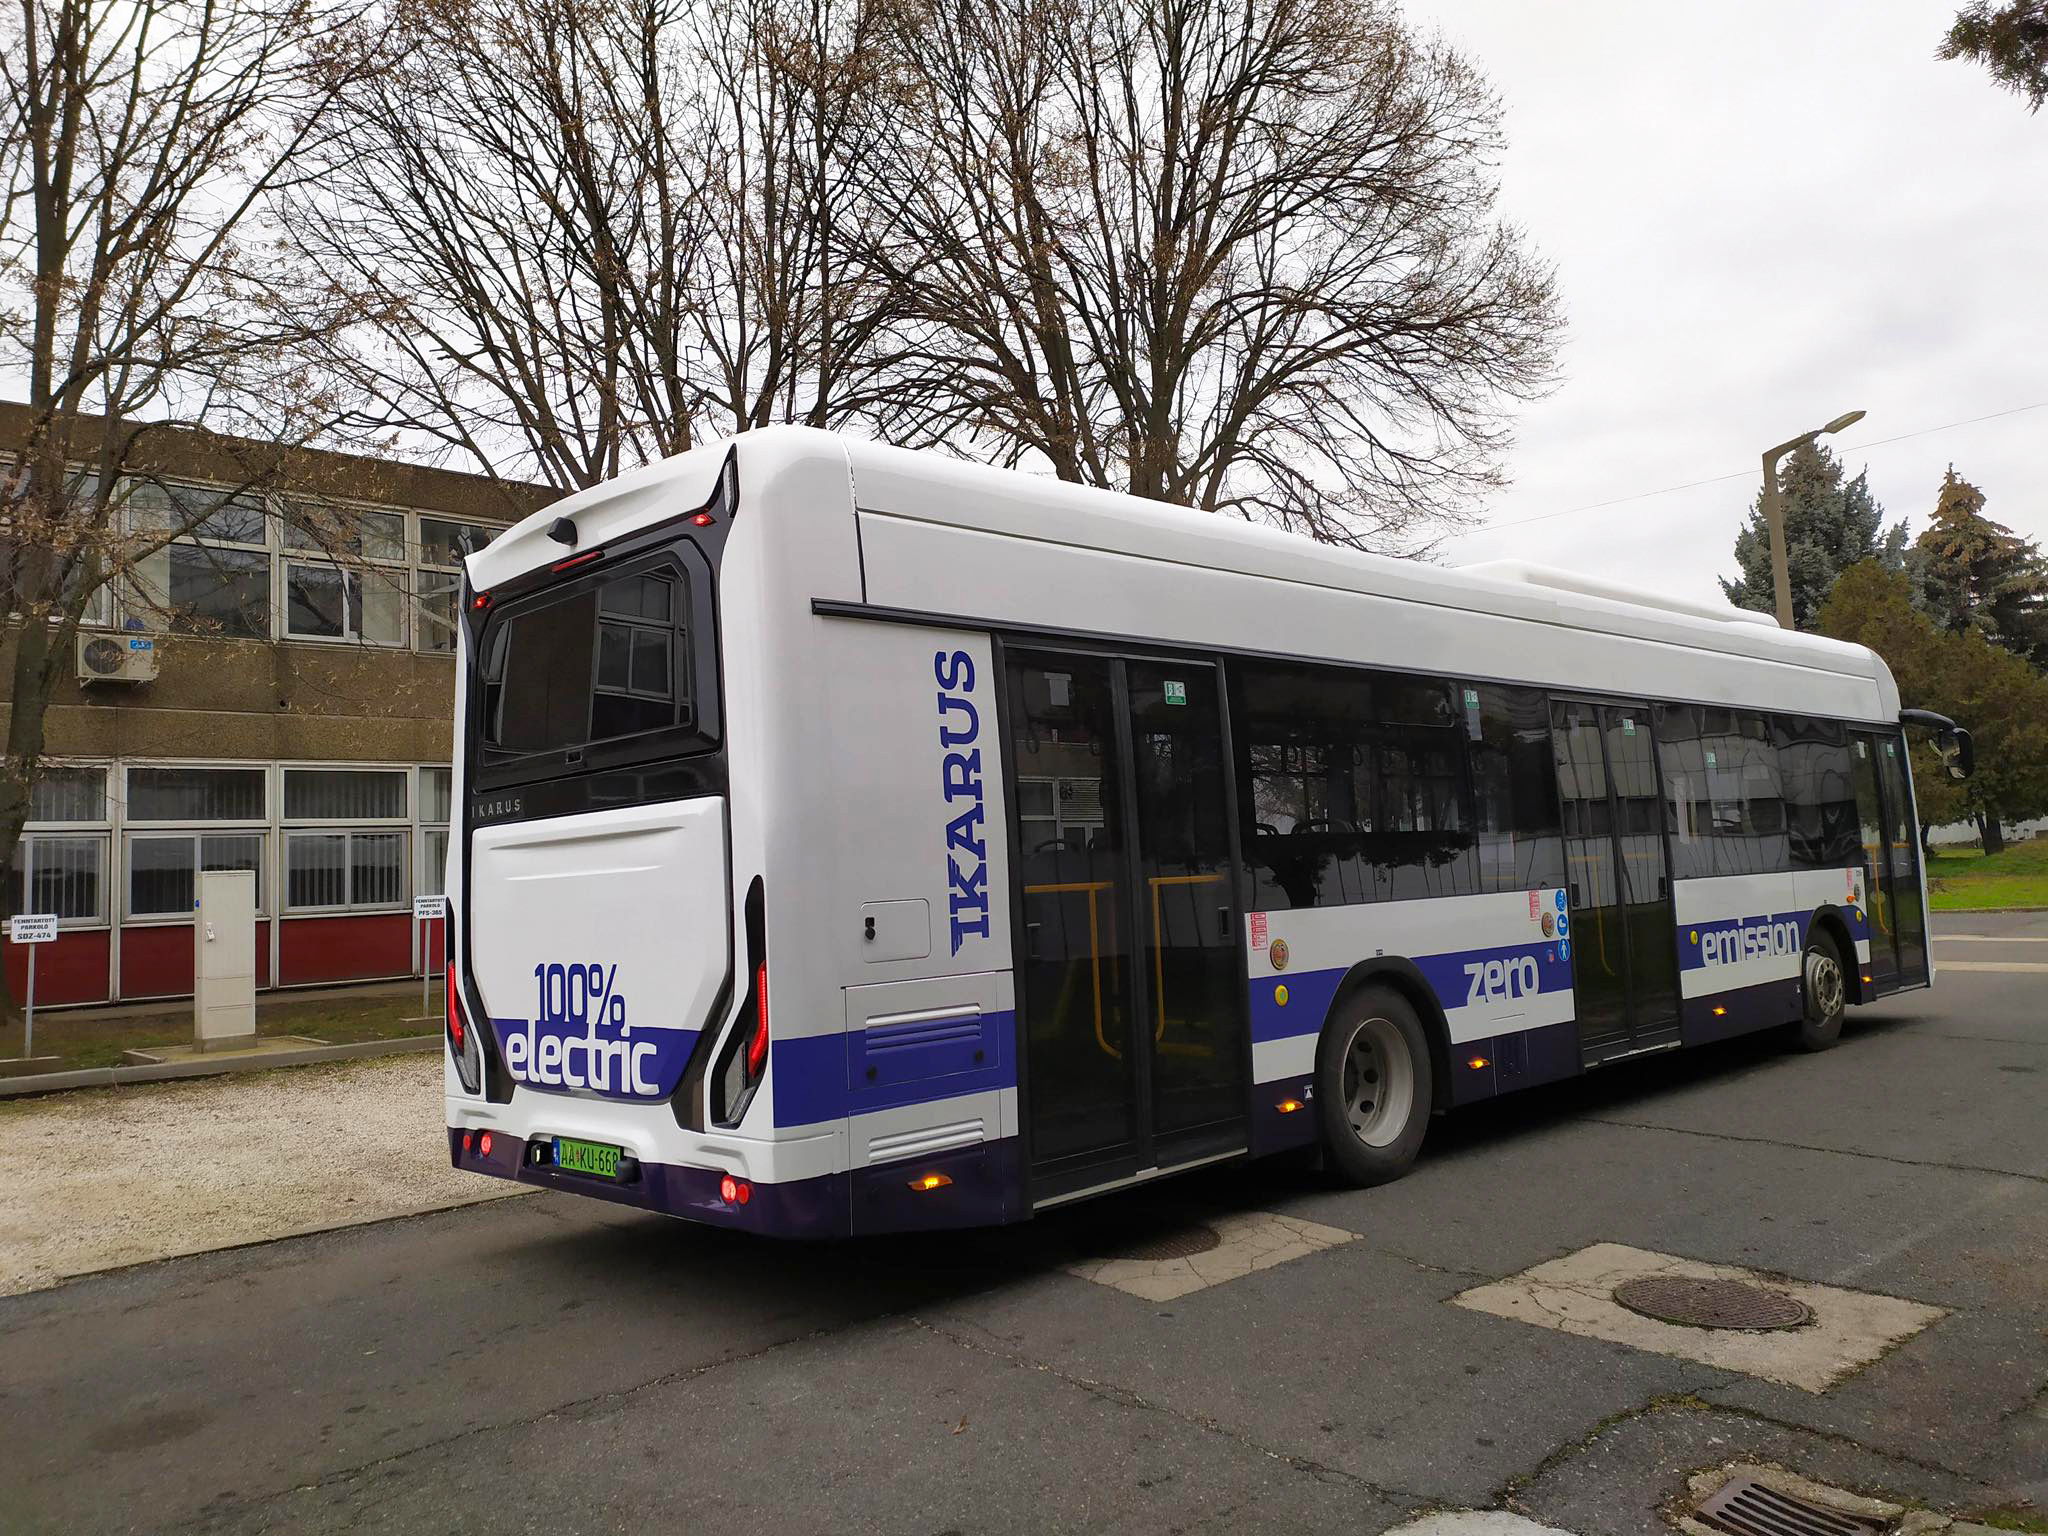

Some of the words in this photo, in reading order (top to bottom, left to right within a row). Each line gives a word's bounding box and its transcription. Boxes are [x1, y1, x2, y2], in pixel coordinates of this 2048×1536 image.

[472, 799, 520, 818] IKARUS
[934, 650, 989, 958] IKARUS
[1702, 915, 1801, 968] emission
[534, 963, 626, 1029] 100%
[1463, 955, 1540, 1008] zero
[505, 1018, 660, 1096] electric
